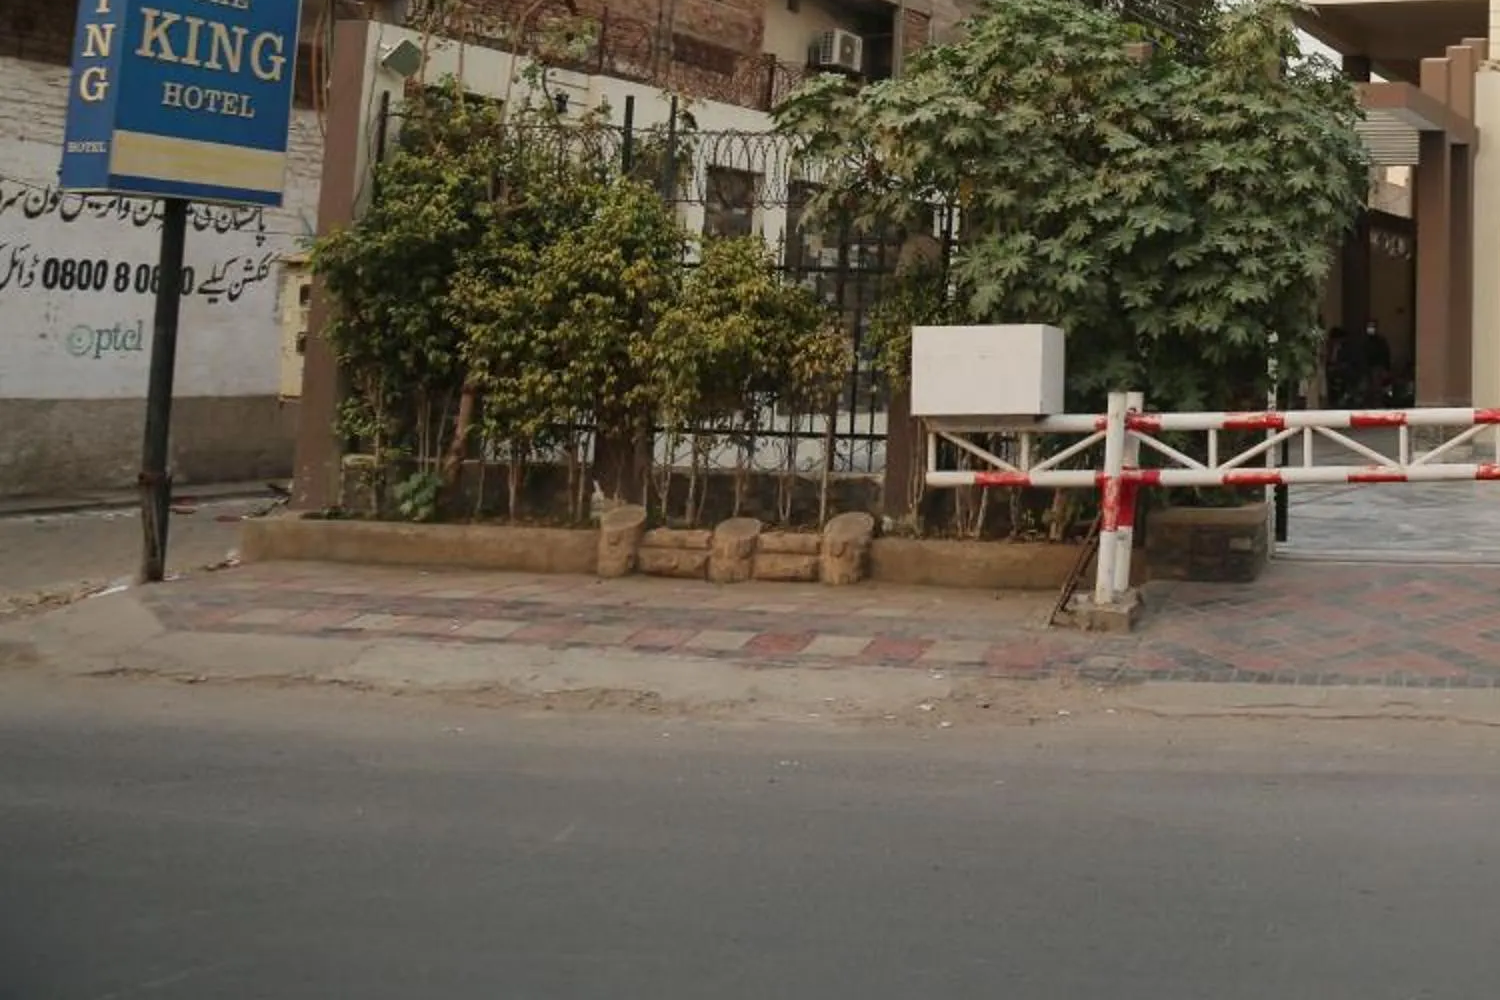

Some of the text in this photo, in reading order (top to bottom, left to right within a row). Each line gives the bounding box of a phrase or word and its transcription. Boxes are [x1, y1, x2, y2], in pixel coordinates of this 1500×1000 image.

[135, 7, 286, 81] KING
[161, 81, 255, 118] HOTEL
[42, 257, 108, 290] 0800
